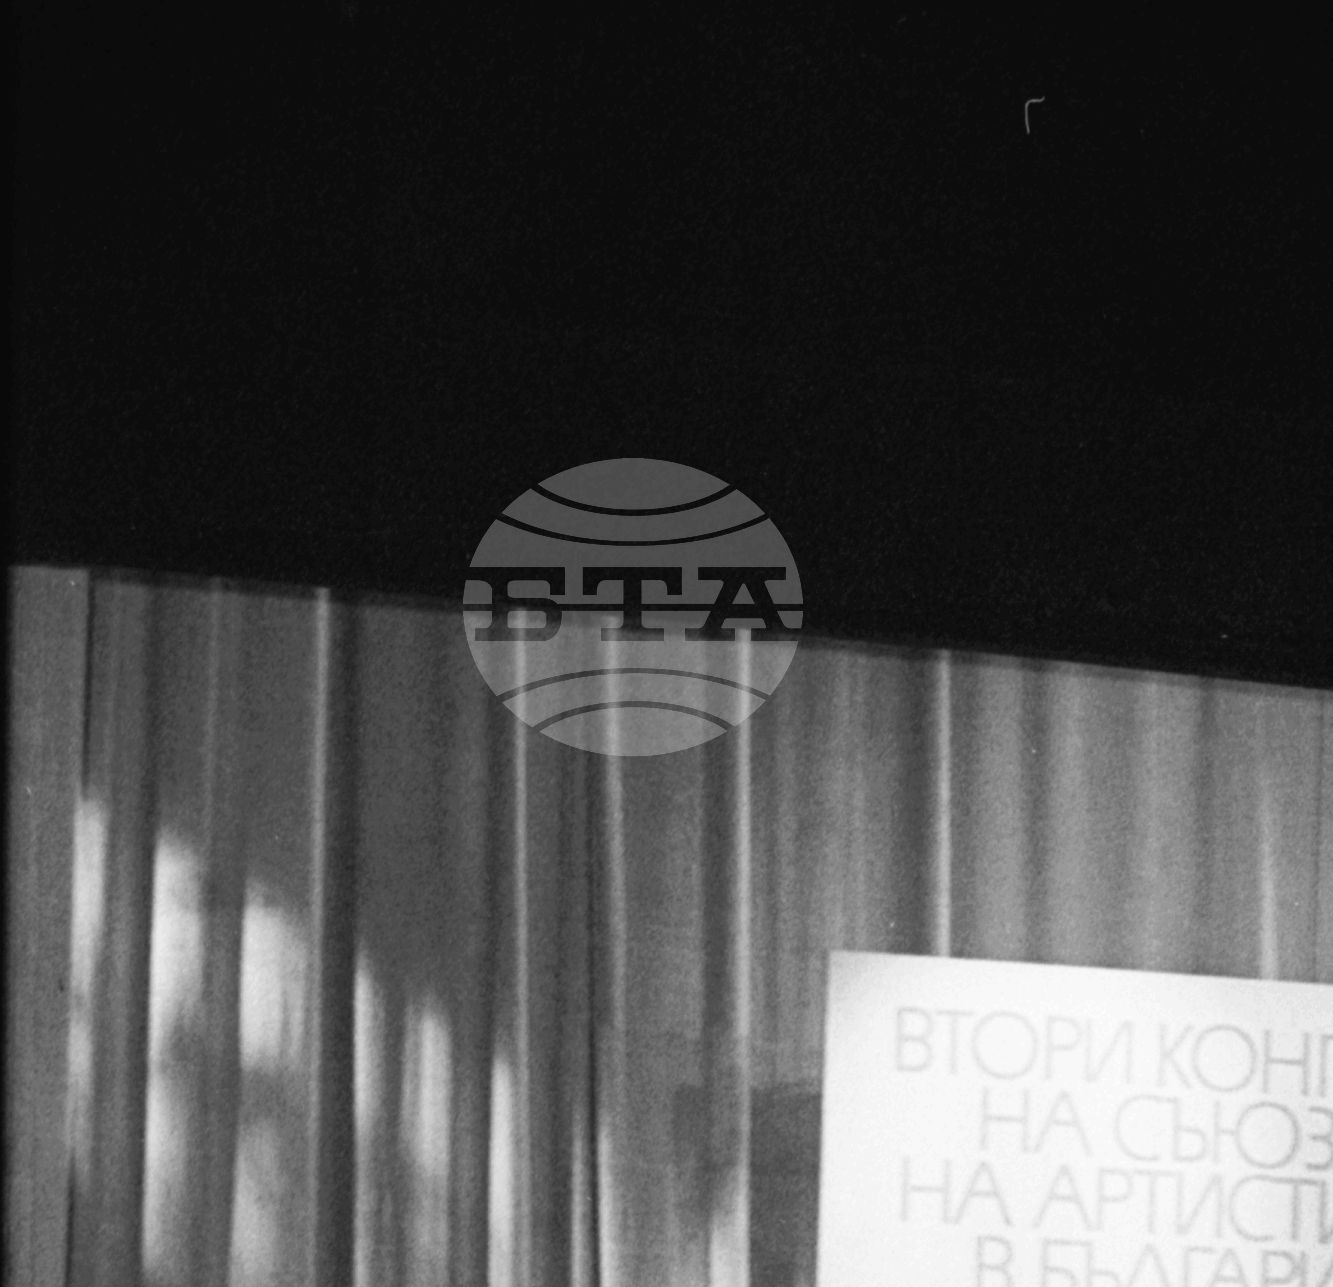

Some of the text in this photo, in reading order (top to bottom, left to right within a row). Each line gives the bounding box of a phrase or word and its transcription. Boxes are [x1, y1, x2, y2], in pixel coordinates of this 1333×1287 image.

[894, 1006, 1135, 1084] ВТОРИ
[979, 1087, 1094, 1158] НА
[900, 1157, 1014, 1229] НА
